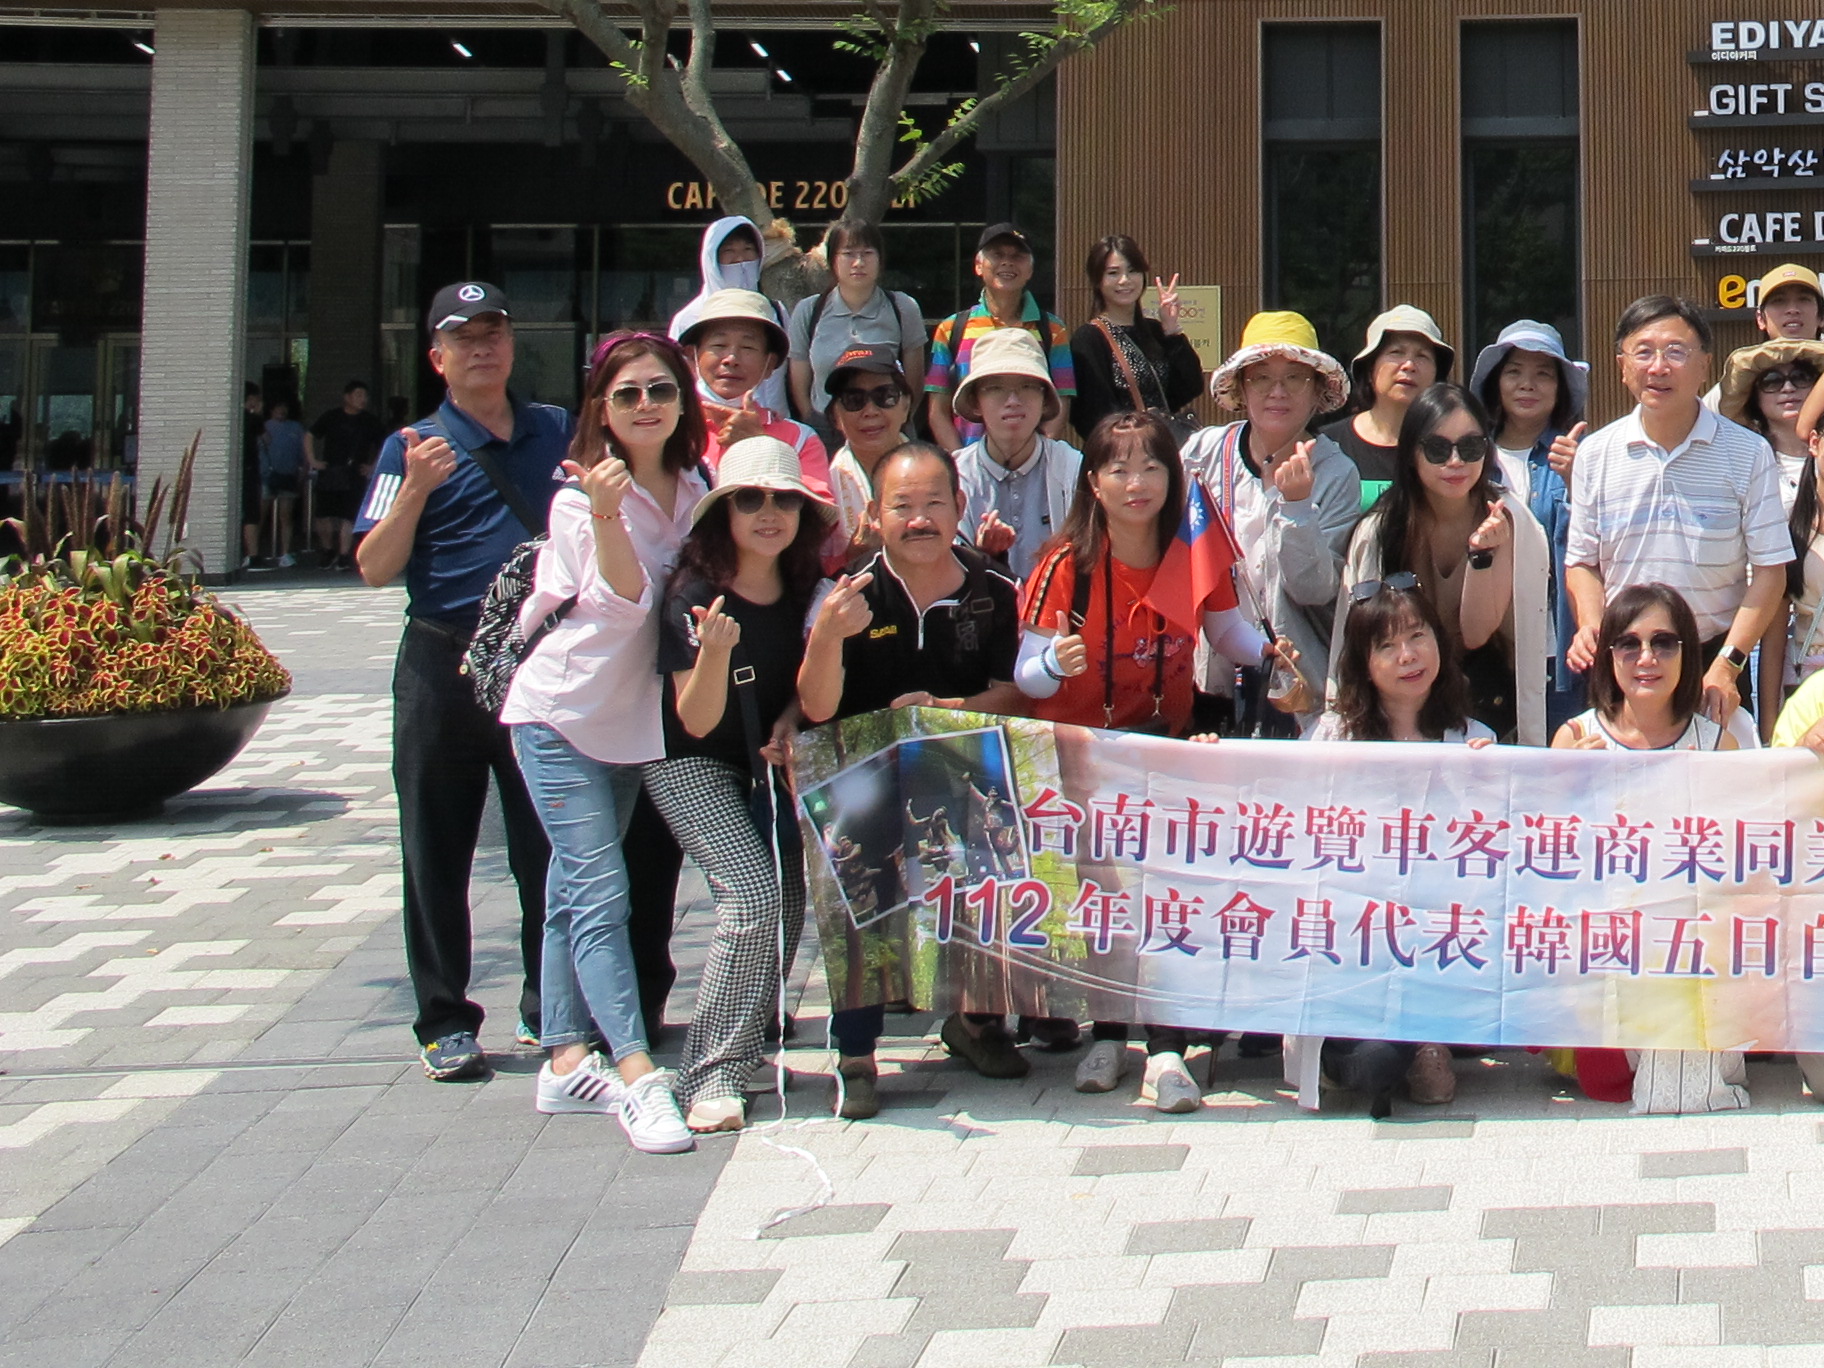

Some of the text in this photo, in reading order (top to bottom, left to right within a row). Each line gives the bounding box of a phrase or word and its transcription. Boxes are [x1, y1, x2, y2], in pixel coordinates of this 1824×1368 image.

[1709, 83, 1792, 116] GIFT
[1717, 147, 1818, 179] 삼악산
[667, 182, 717, 209] CAF
[1719, 212, 1801, 244] CAFE
